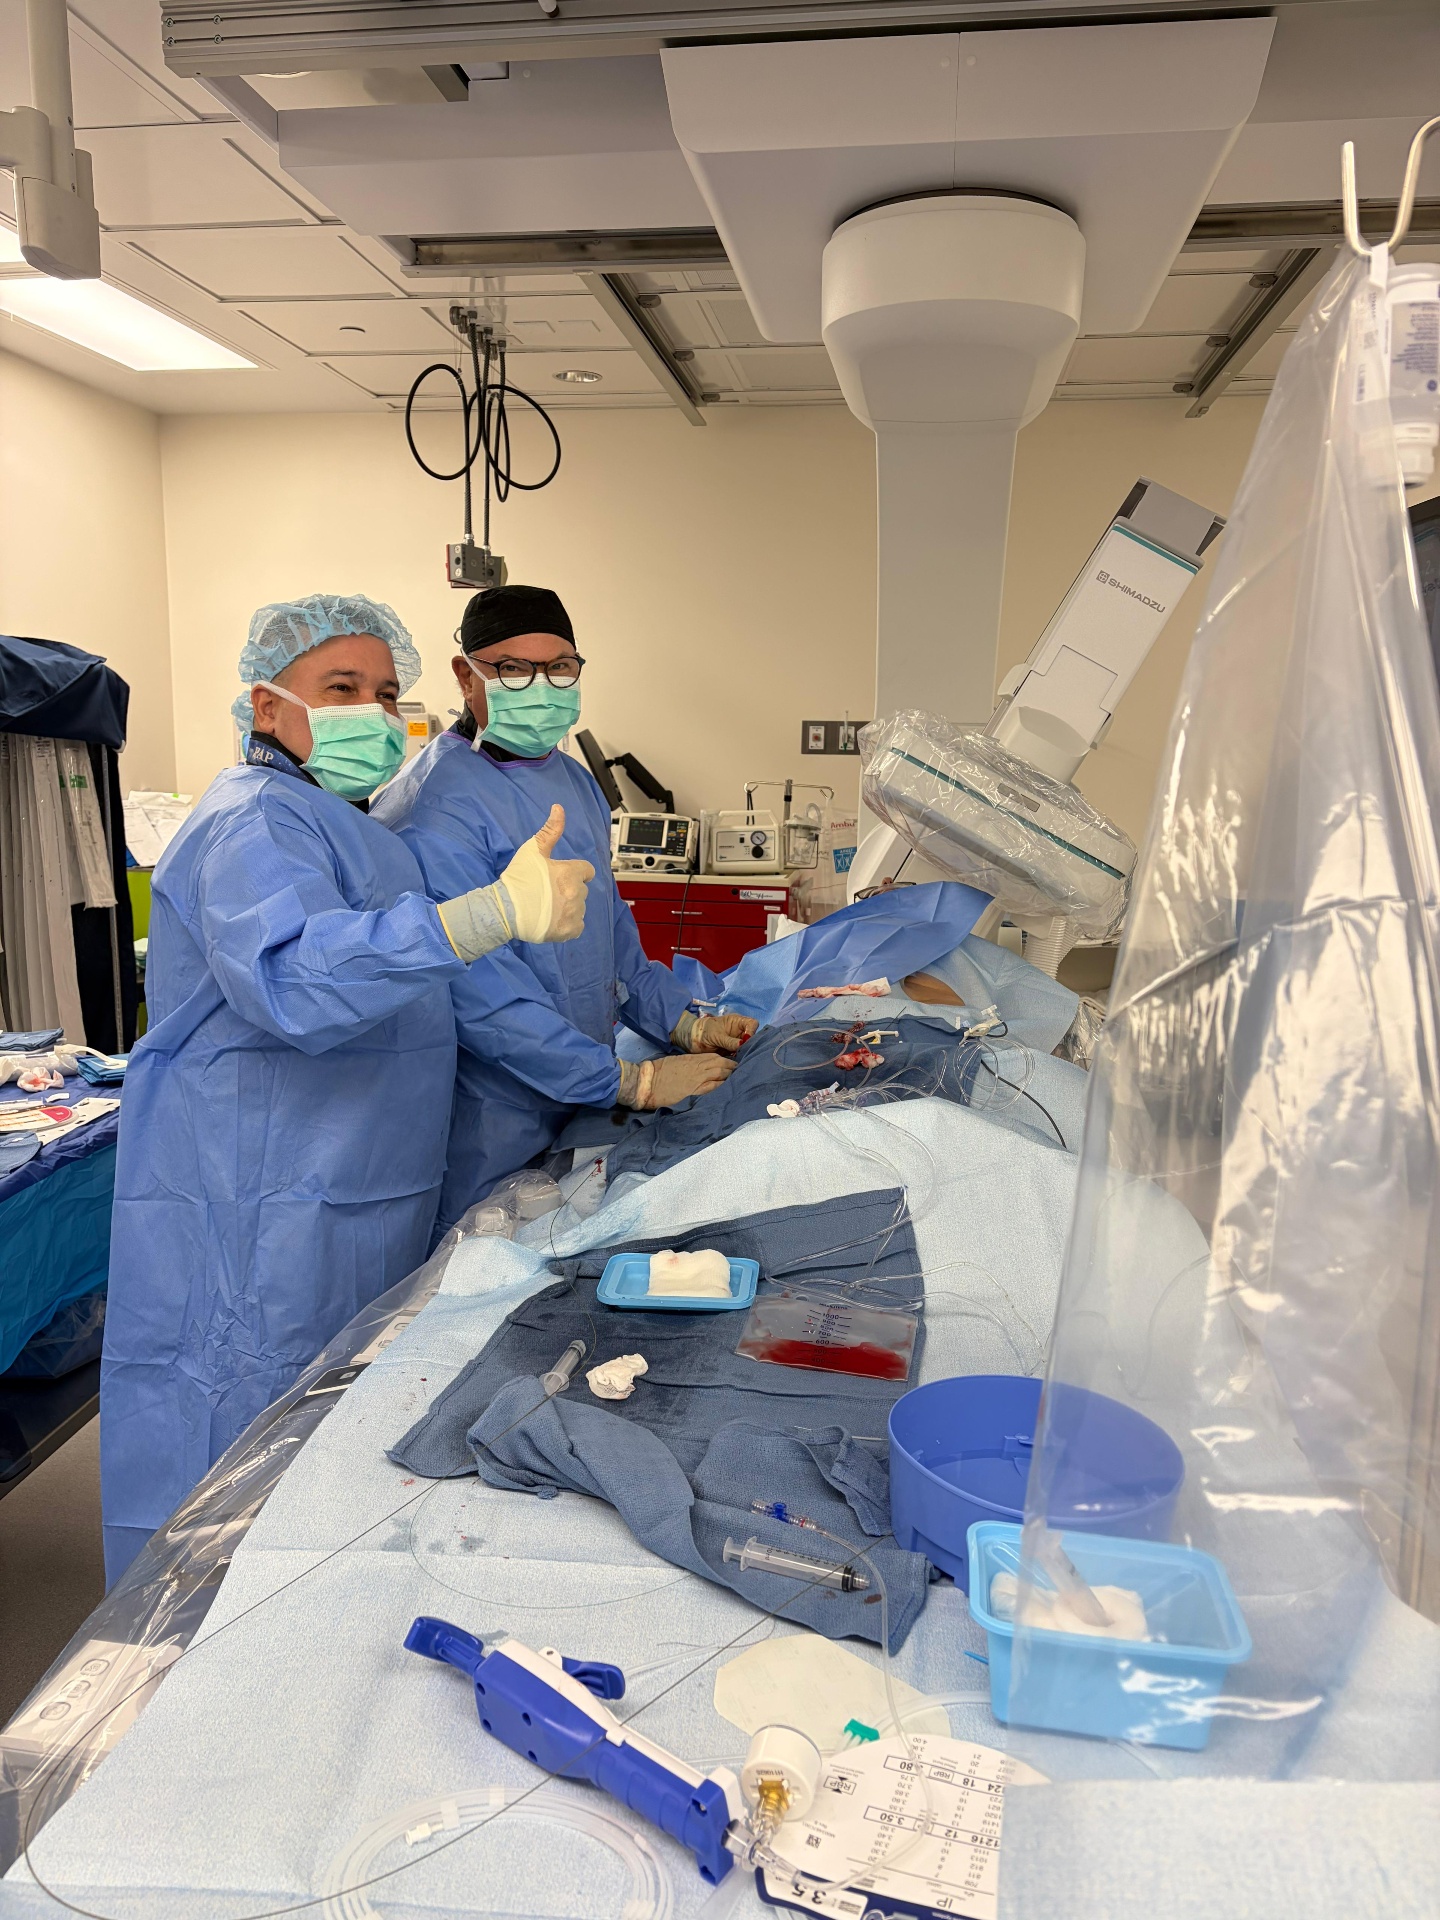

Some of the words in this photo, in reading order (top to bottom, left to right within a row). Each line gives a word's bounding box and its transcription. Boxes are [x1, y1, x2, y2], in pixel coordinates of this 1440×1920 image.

[1108, 578, 1166, 614] SHIMADZU
[933, 1770, 951, 1779] RBP
[830, 1780, 851, 1791] RBP
[962, 1778, 976, 1788] 18
[987, 1784, 1004, 1794] 24
[879, 1812, 905, 1825] 3.50
[944, 1829, 959, 1839] 12
[971, 1835, 1000, 1848] 1216
[936, 1897, 953, 1909] IP
